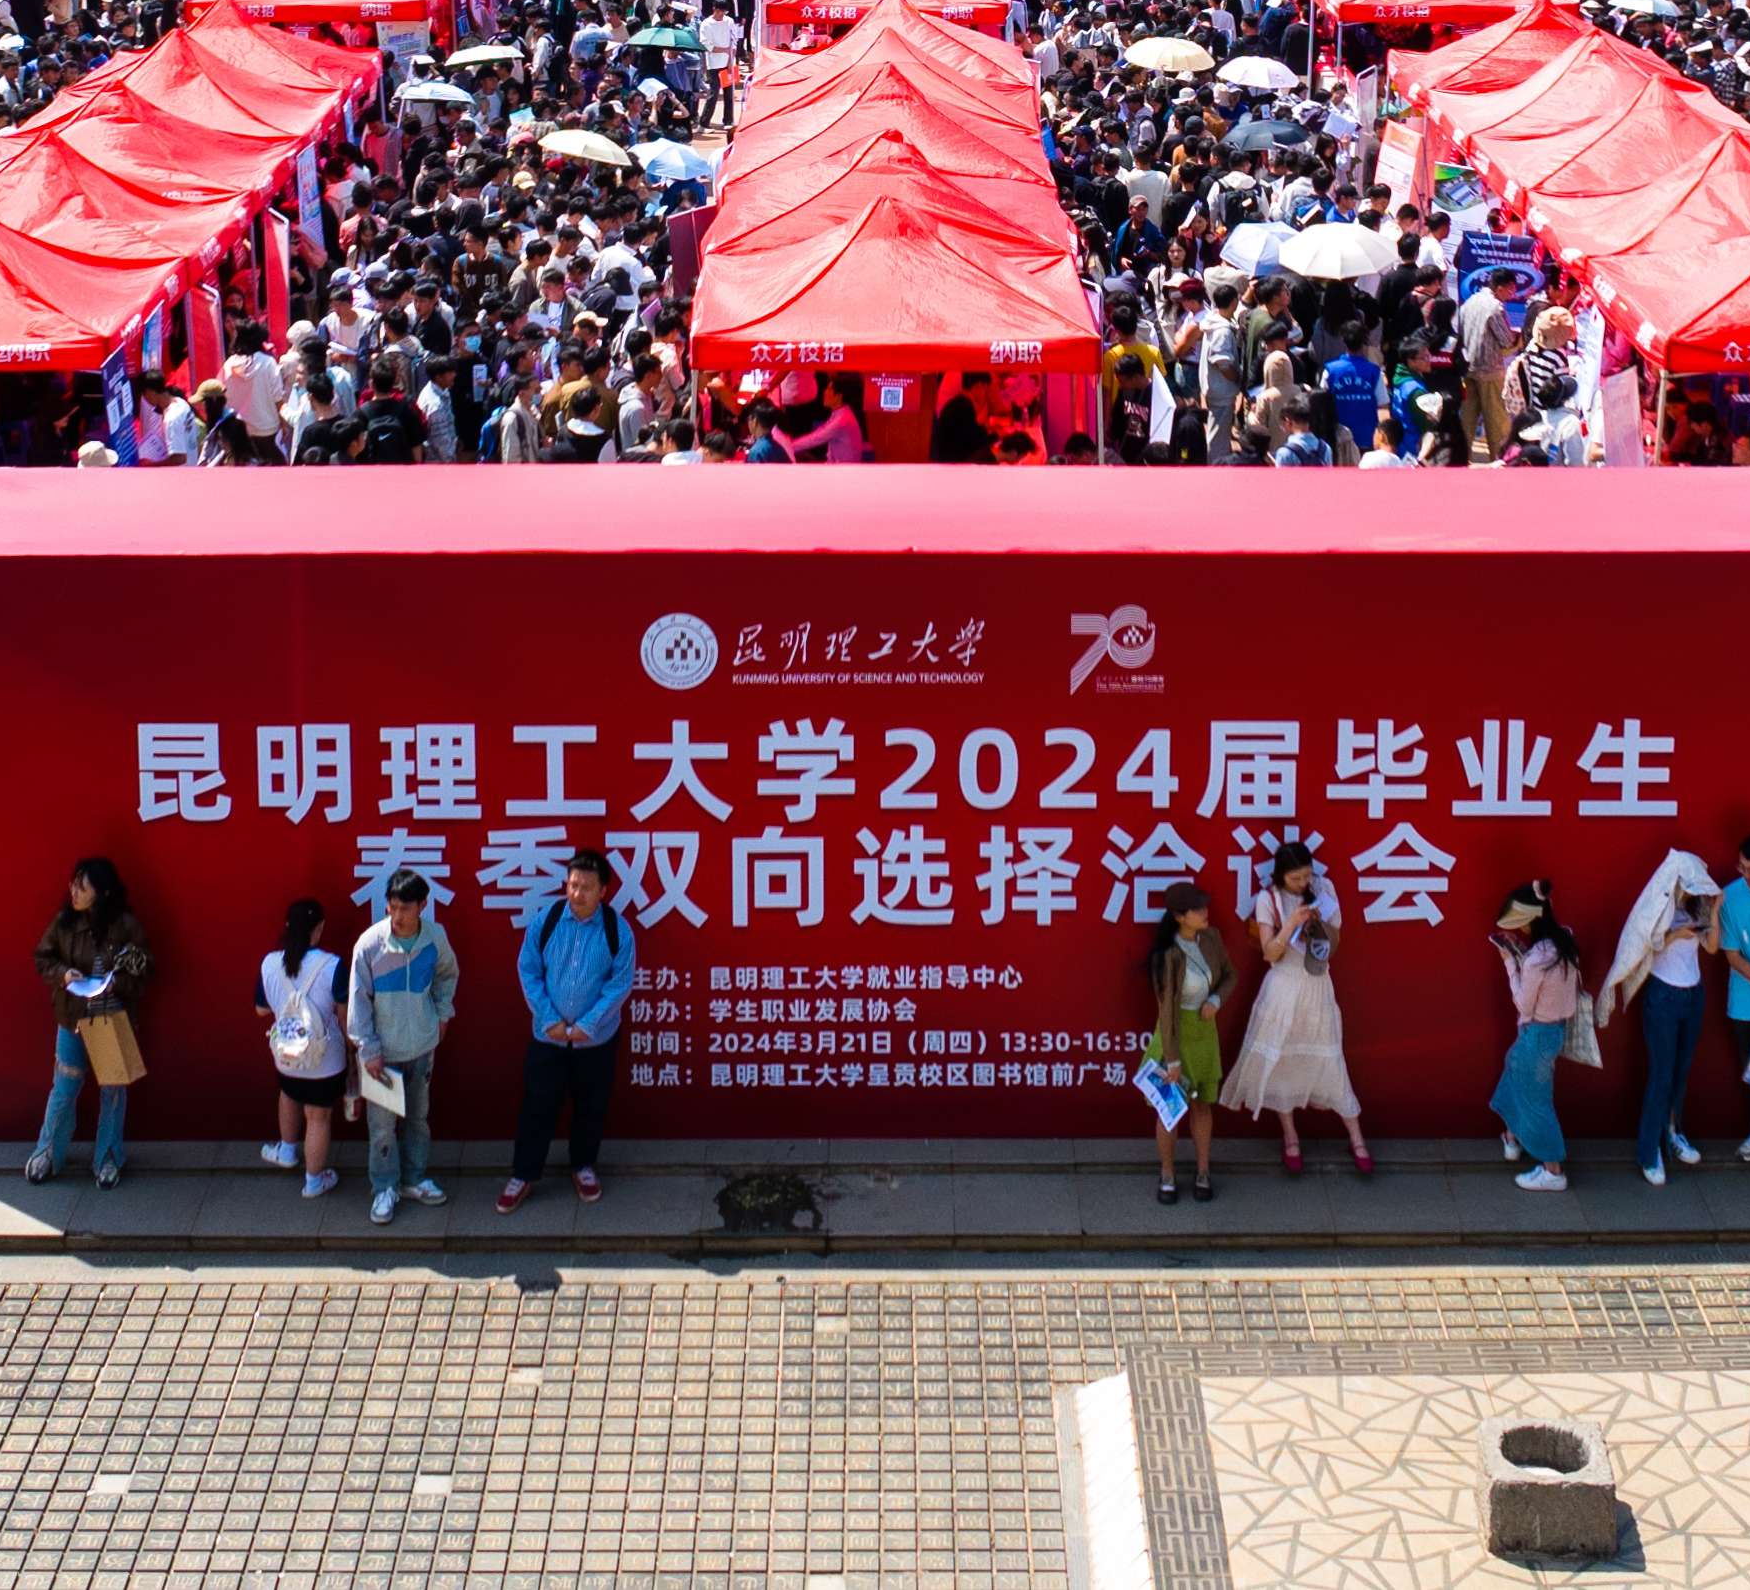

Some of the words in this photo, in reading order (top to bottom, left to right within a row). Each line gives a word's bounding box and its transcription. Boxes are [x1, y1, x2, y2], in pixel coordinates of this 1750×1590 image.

[801, 6, 858, 20] 众才校招
[750, 342, 845, 363] 众才校招
[989, 340, 1043, 364] 纳职
[732, 673, 779, 686] KUNMING
[781, 673, 835, 686] UNIVERSITY
[837, 673, 851, 686] OF
[853, 673, 892, 686] SCIENCE
[895, 673, 917, 686] AND
[920, 673, 985, 686] TECHNOLOGY
[136, 717, 1679, 824] 昆明理工大学2024届毕业生
